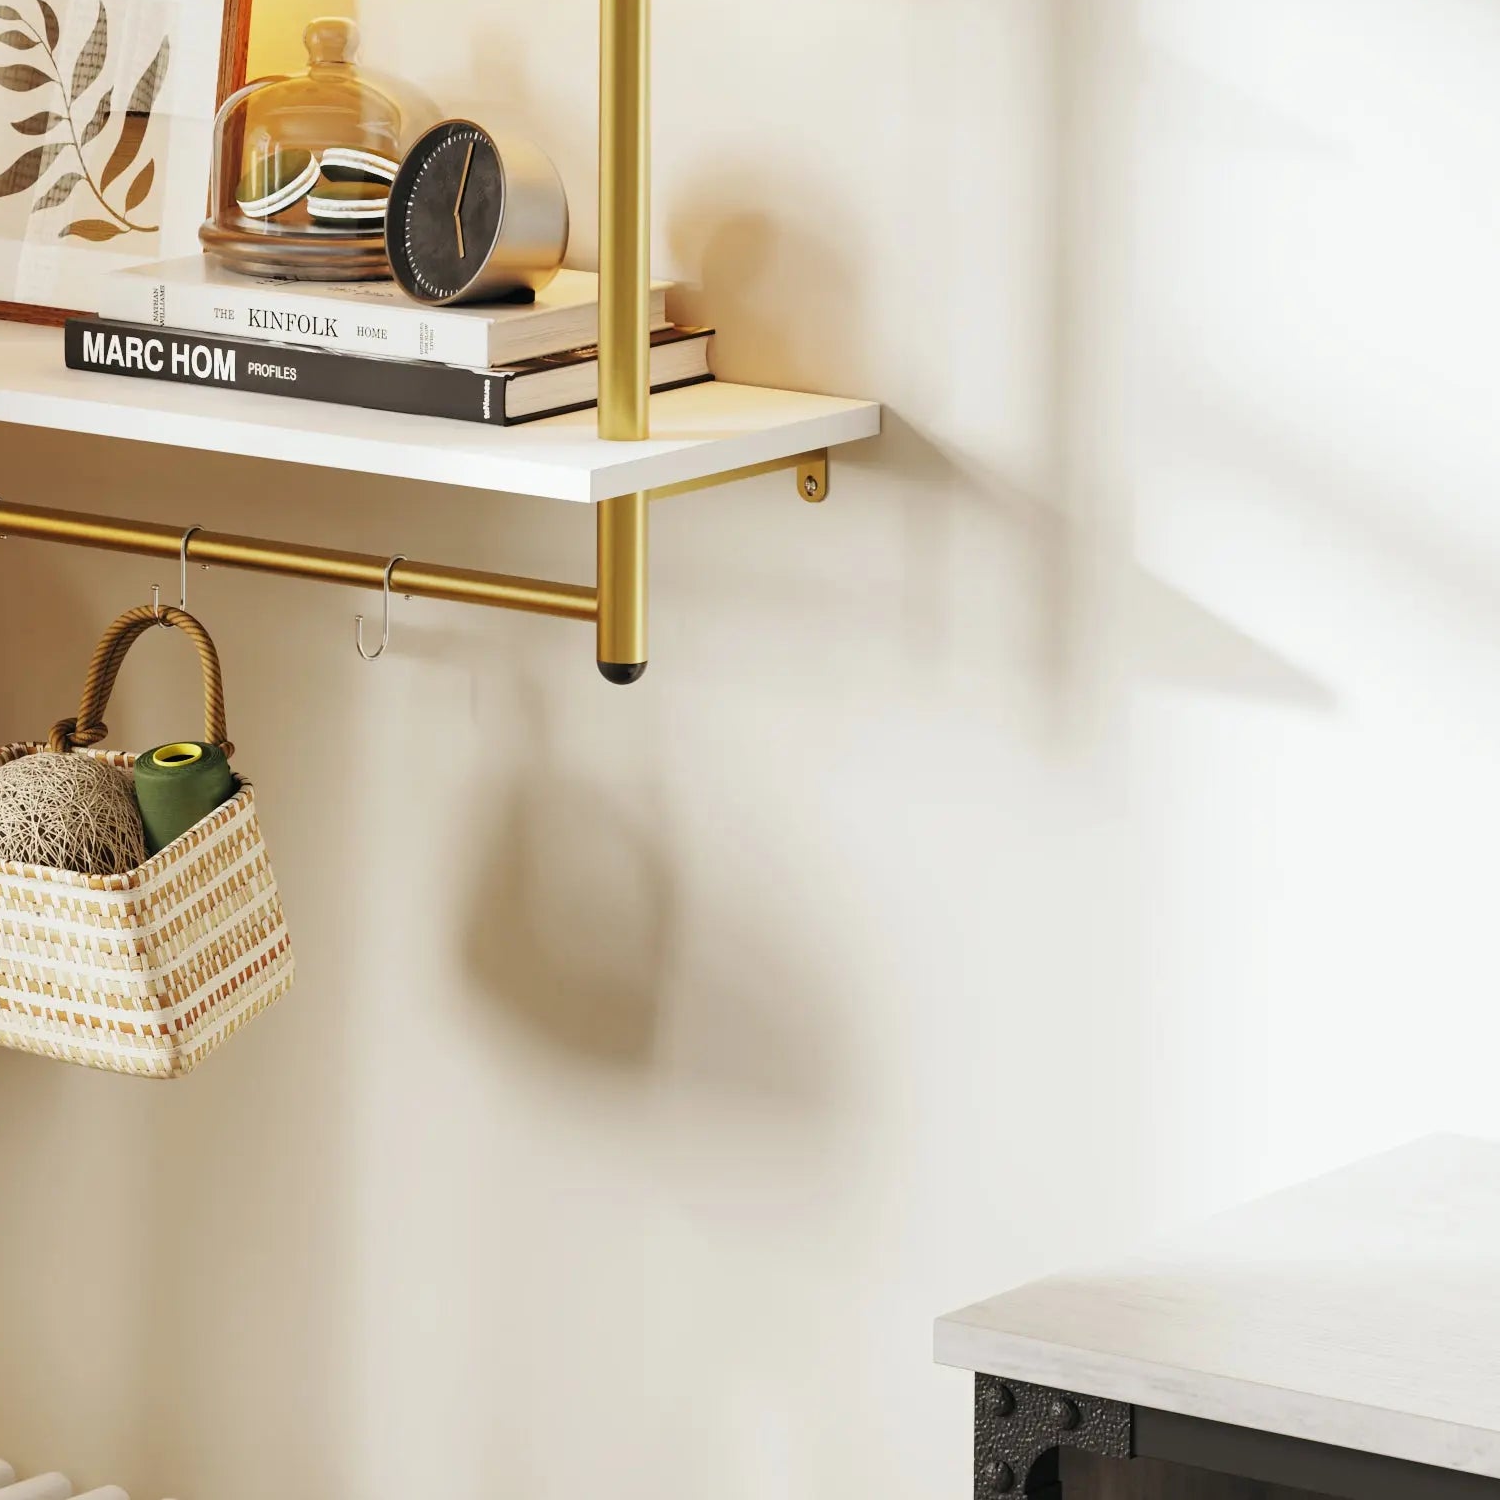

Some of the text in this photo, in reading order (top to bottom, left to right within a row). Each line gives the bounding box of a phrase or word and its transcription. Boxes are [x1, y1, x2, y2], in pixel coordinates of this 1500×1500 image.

[214, 308, 388, 340] THE KINFOLK HOME
[83, 331, 297, 382] MARC HOM PROFILES
